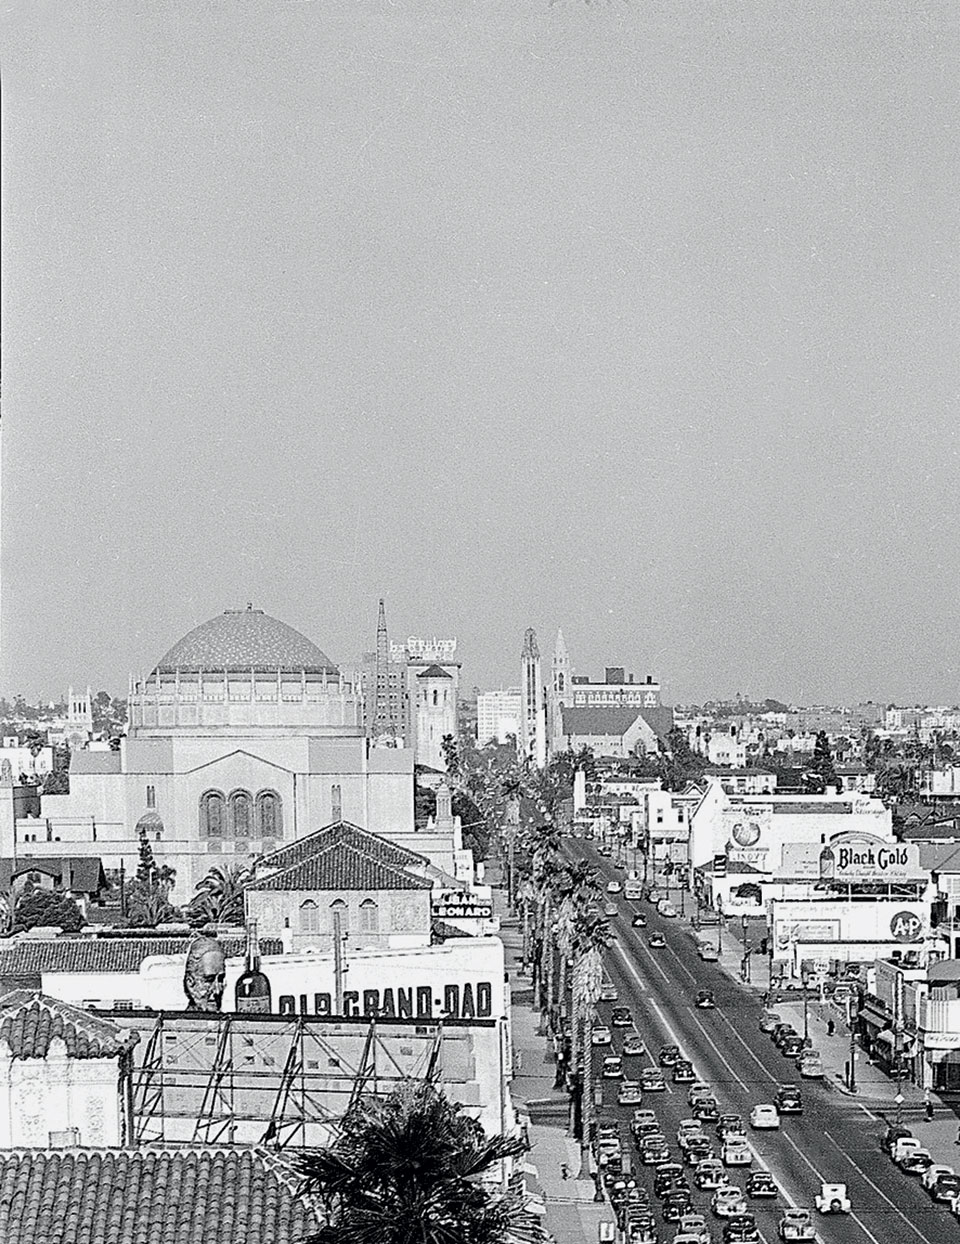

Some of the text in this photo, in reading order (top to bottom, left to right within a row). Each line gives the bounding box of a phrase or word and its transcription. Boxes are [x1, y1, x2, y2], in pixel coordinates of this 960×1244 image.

[836, 847, 908, 870] Black Gold
[431, 906, 492, 916] LEONARD
